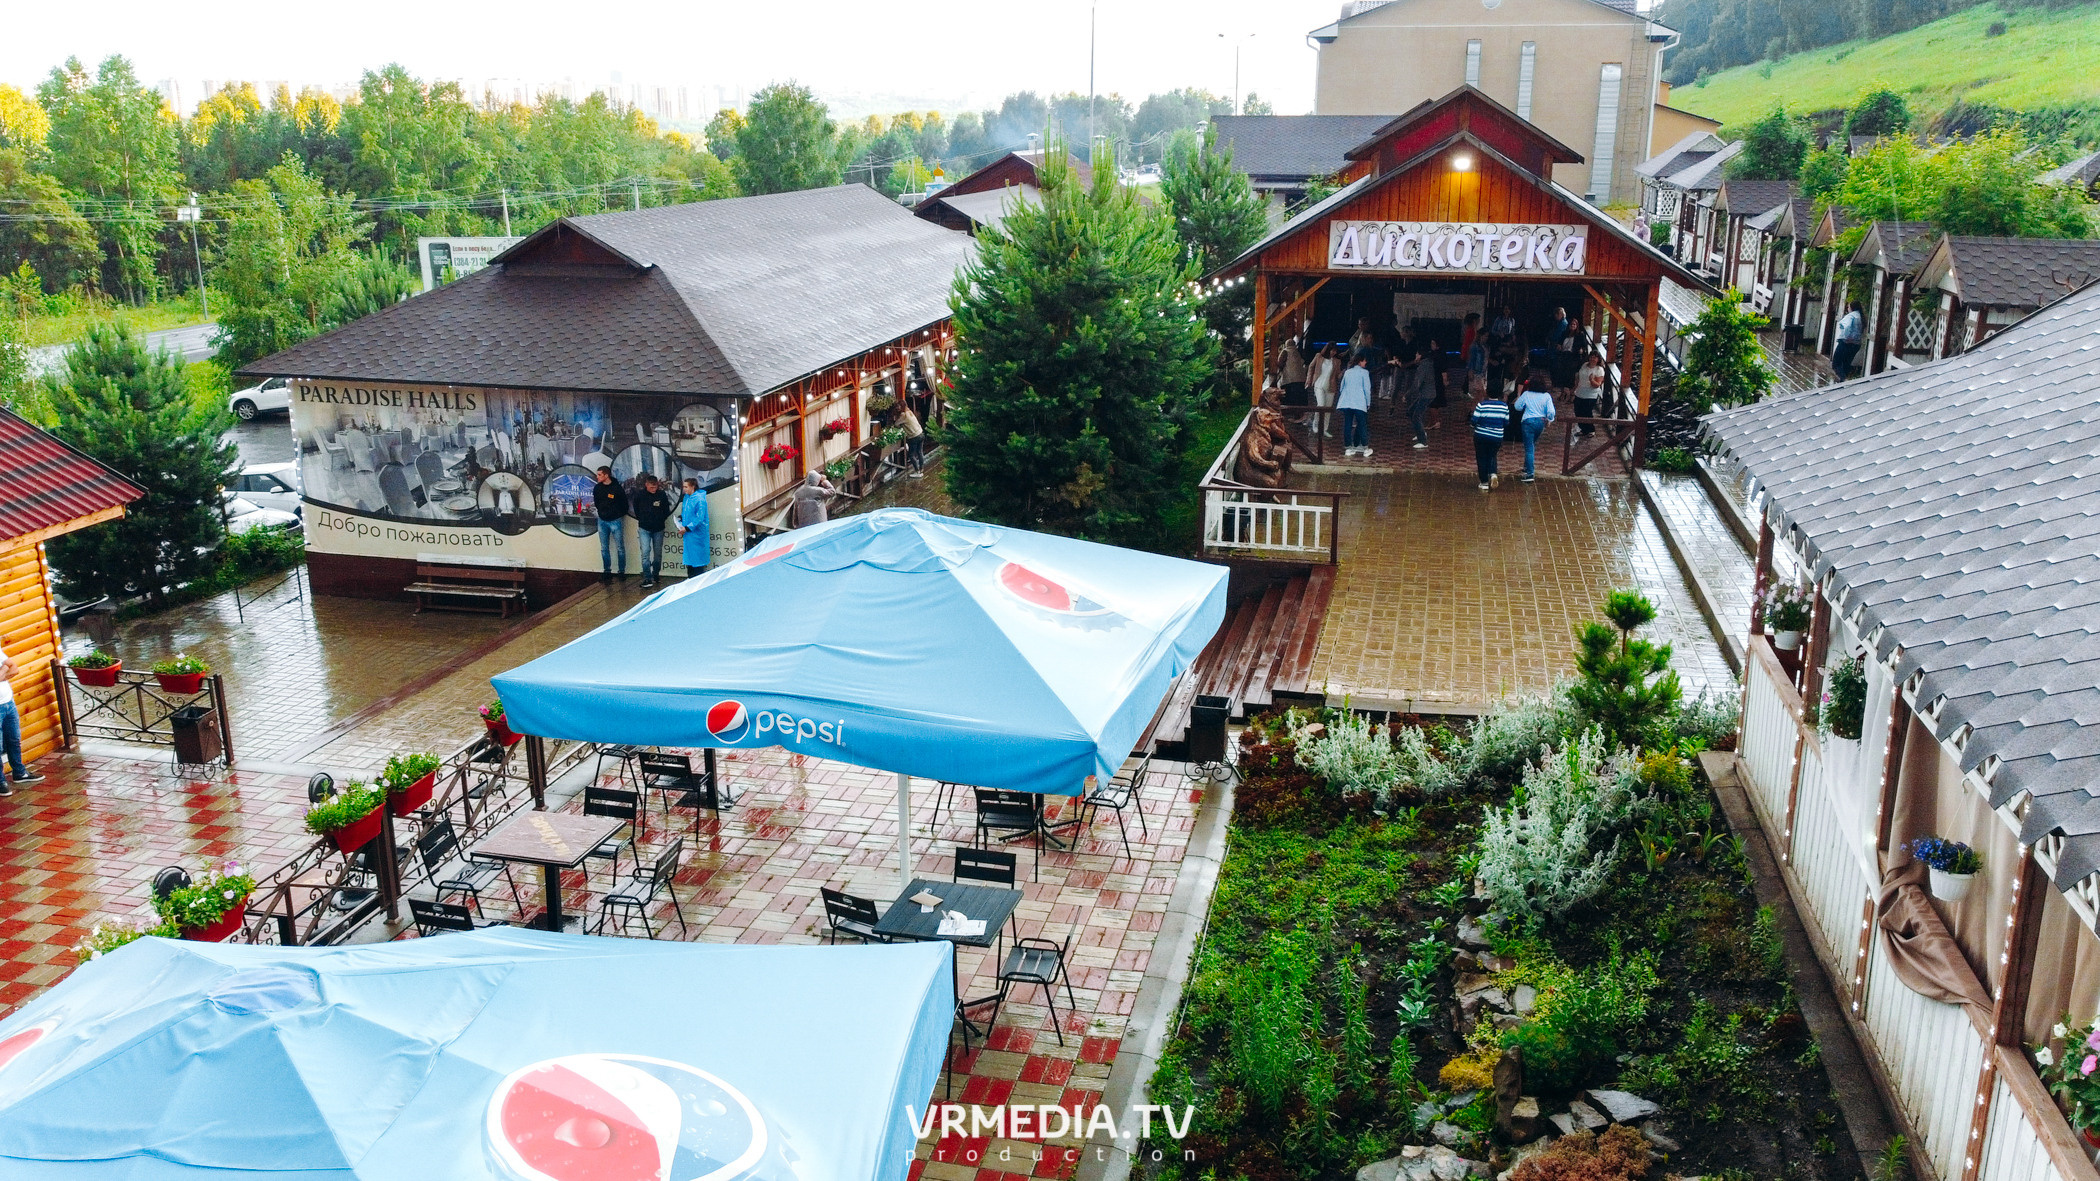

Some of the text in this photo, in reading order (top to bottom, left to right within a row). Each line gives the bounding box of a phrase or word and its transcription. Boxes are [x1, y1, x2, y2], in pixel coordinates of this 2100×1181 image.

[1332, 226, 1586, 270] Дискотека
[299, 385, 477, 411] PARADISE HALLS
[318, 511, 504, 546] Добро пожаловать
[725, 532, 736, 541] 61
[664, 544, 683, 555] 906
[724, 547, 738, 557] 36
[755, 710, 845, 745] pepsi
